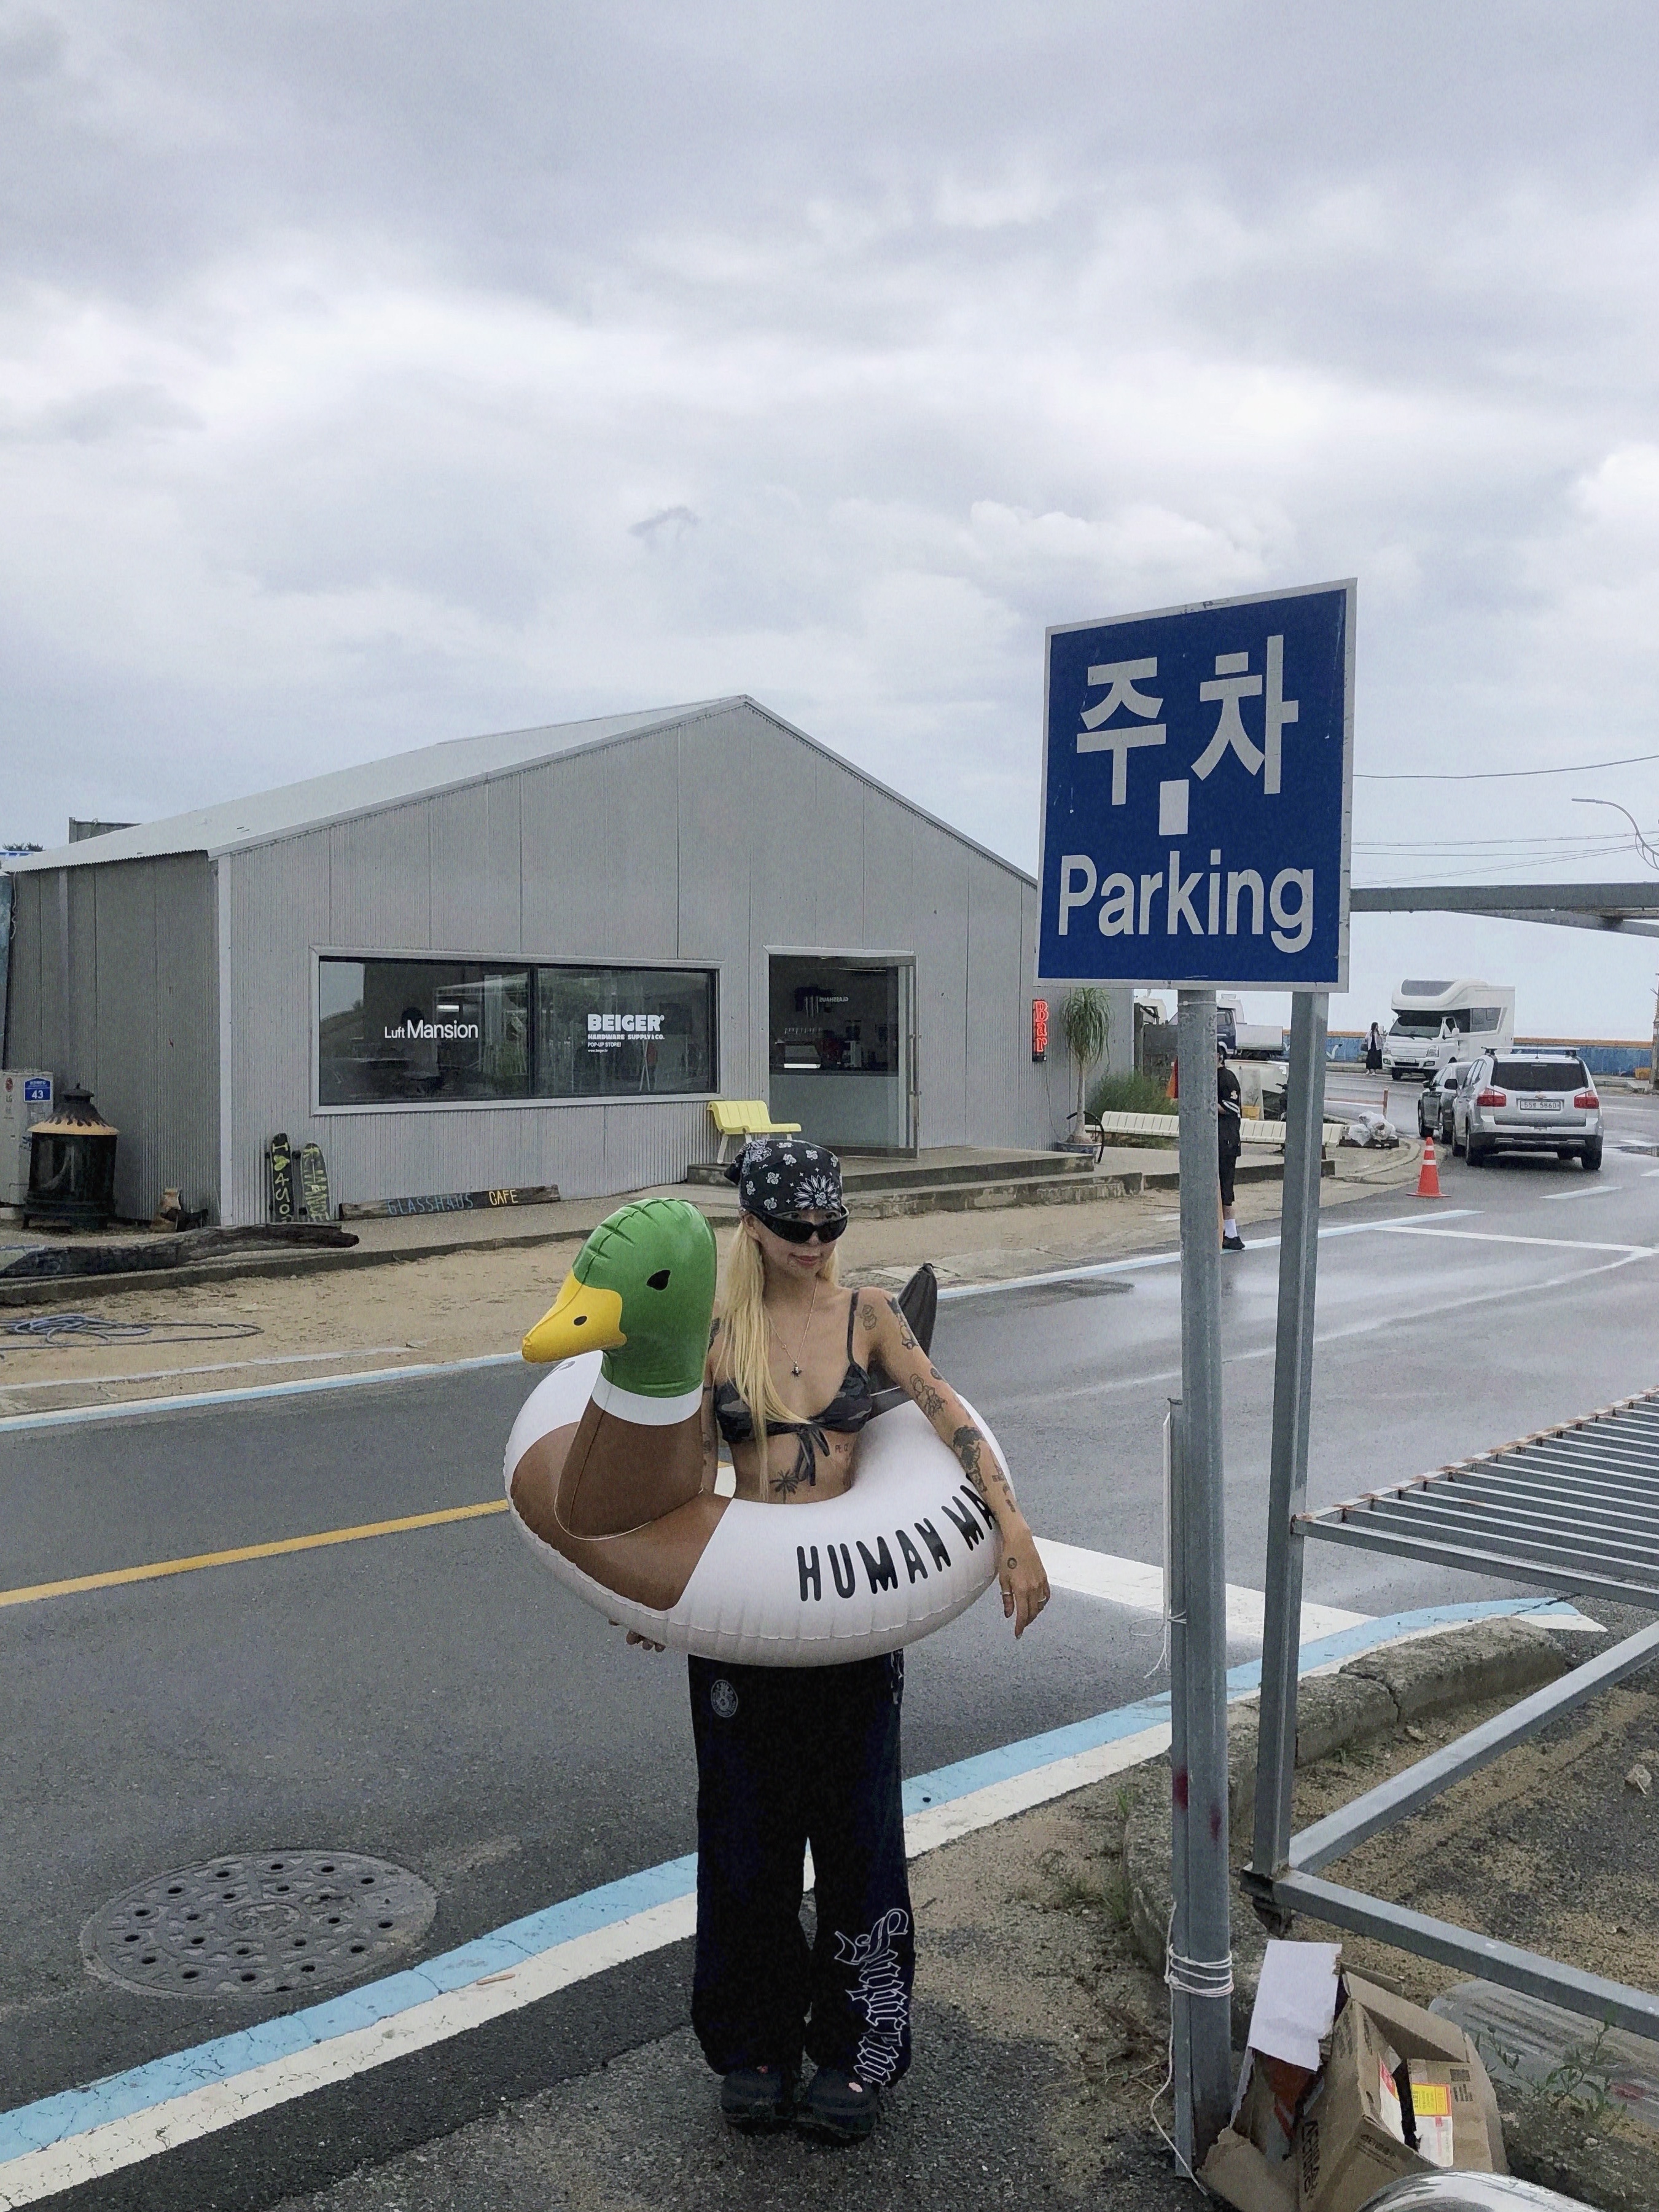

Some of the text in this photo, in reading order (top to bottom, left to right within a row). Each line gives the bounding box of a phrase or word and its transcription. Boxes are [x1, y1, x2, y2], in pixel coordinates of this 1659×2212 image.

[1077, 635, 1299, 805] 주차
[1058, 849, 1314, 953] Parking
[384, 1019, 478, 1039] Luft Mansion
[1036, 1001, 1049, 1052] Bar
[31, 1090, 44, 1099] 43
[387, 1189, 518, 1215] GLASSHAUS CAFE
[797, 1517, 951, 1602] HUMAN
